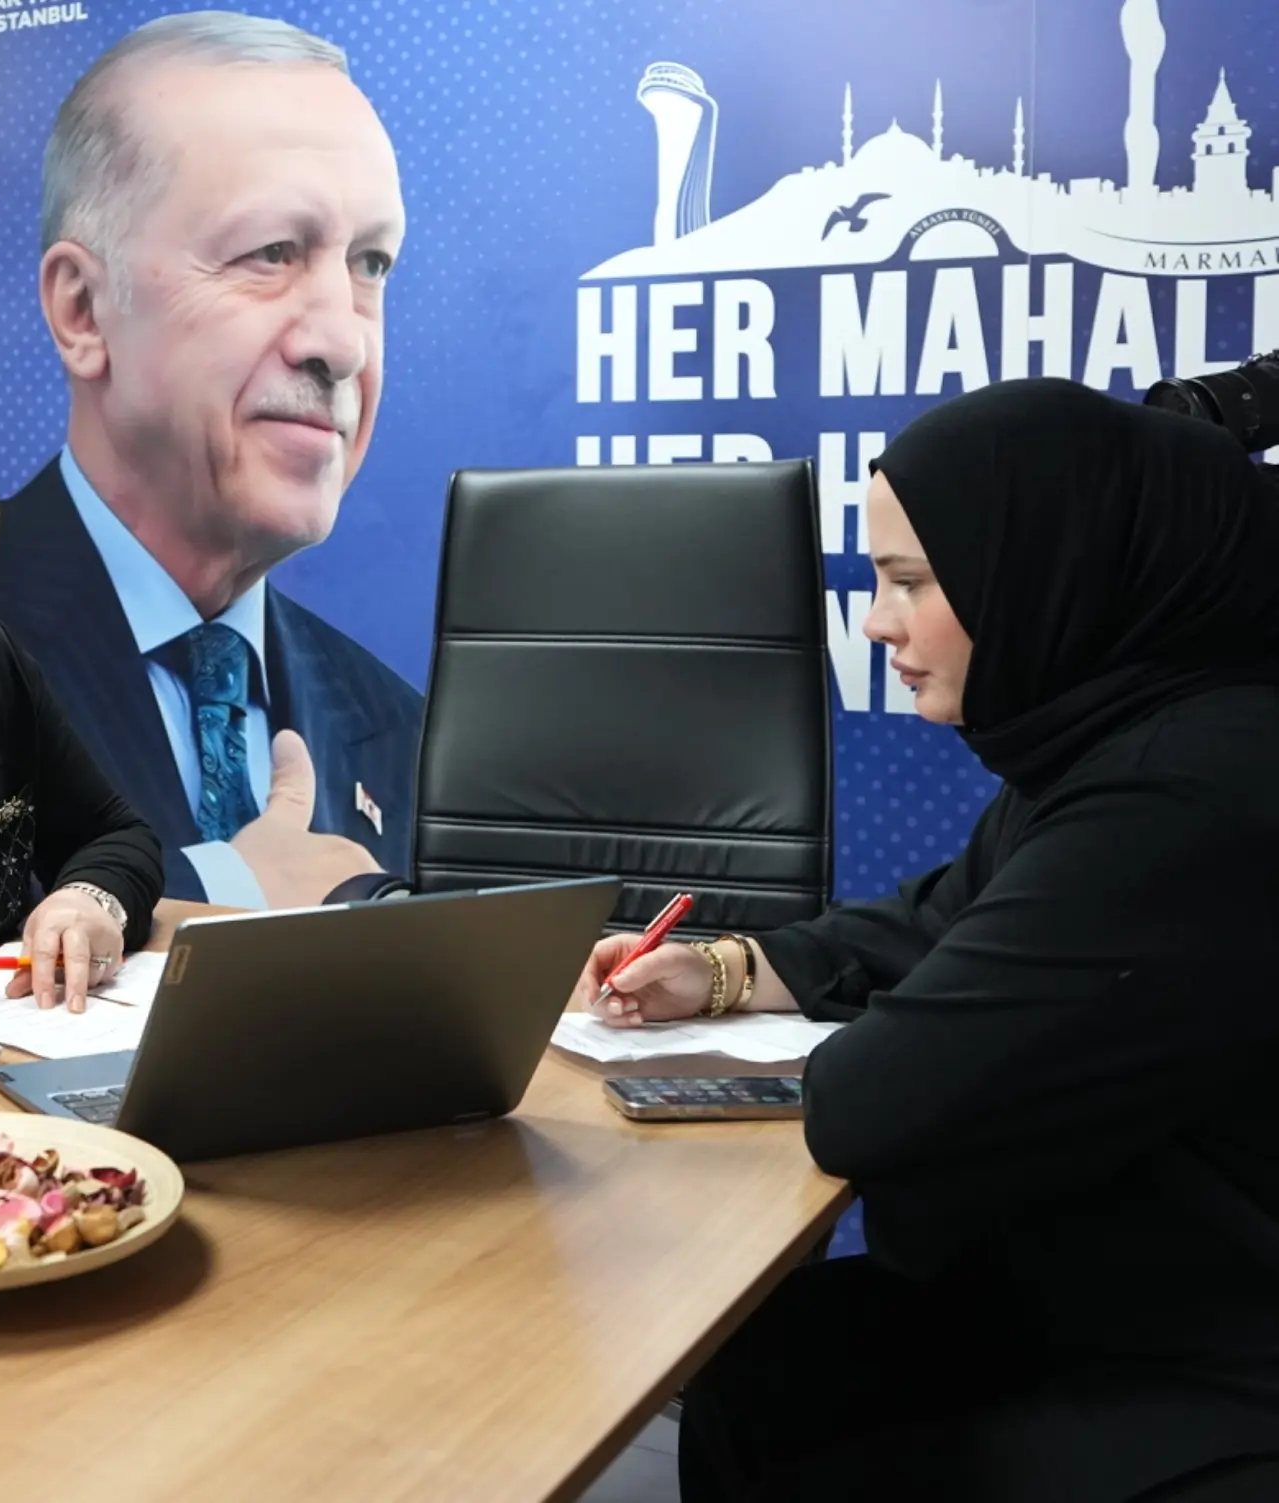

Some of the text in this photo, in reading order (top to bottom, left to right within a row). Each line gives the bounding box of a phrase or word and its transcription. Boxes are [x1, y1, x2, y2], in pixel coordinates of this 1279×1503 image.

[909, 211, 958, 239] AVRASYA
[1144, 247, 1279, 270] MARMA
[577, 278, 777, 403] HER
